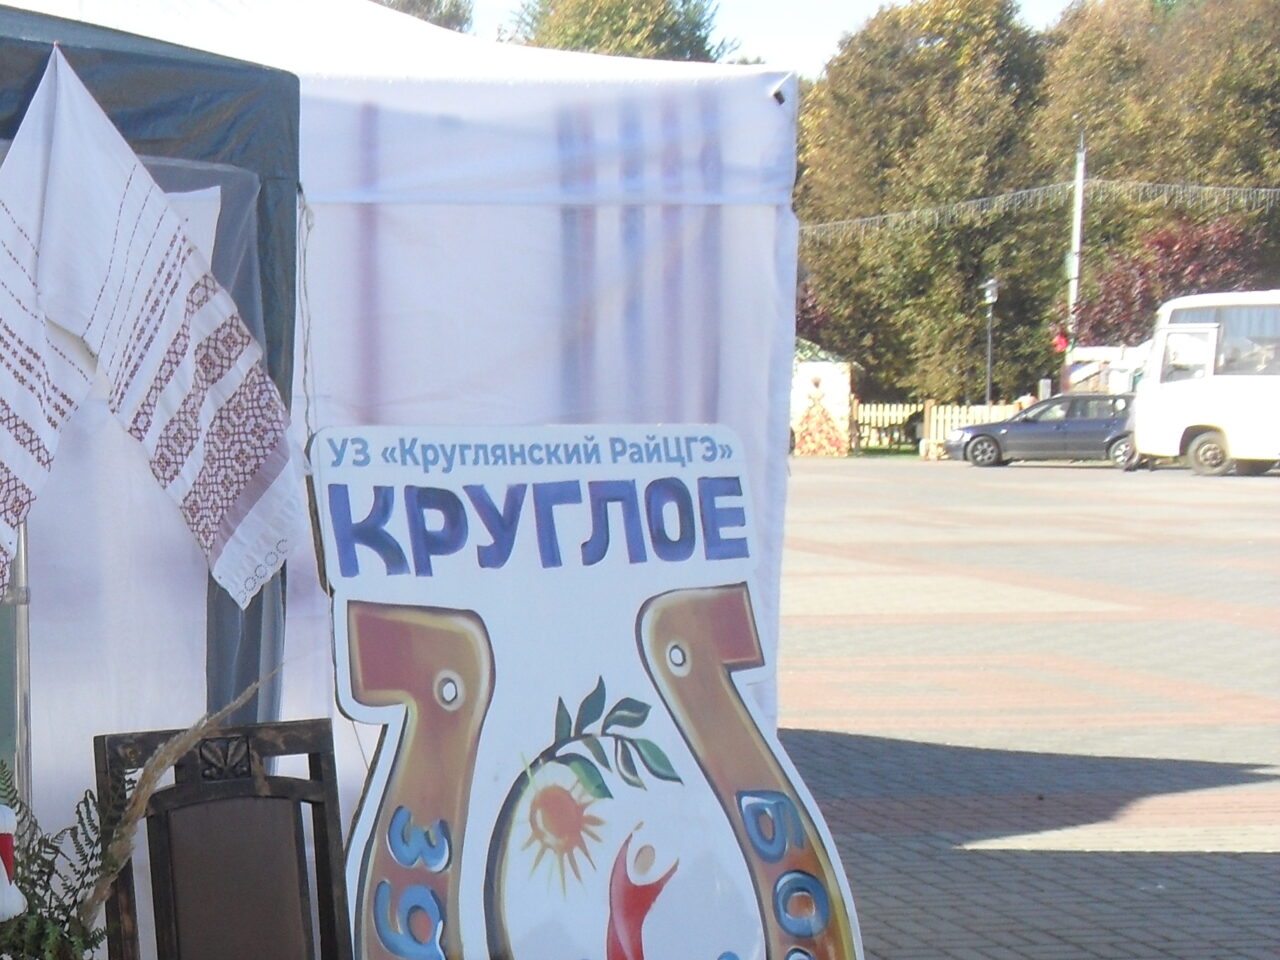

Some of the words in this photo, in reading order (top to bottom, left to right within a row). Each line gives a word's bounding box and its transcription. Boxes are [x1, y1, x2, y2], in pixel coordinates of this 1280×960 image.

[327, 436, 372, 468] УЗ
[381, 436, 602, 473] «Круглянский
[610, 434, 734, 468] РайЦГЭ»
[328, 476, 750, 577] КРУГЛОЕ
